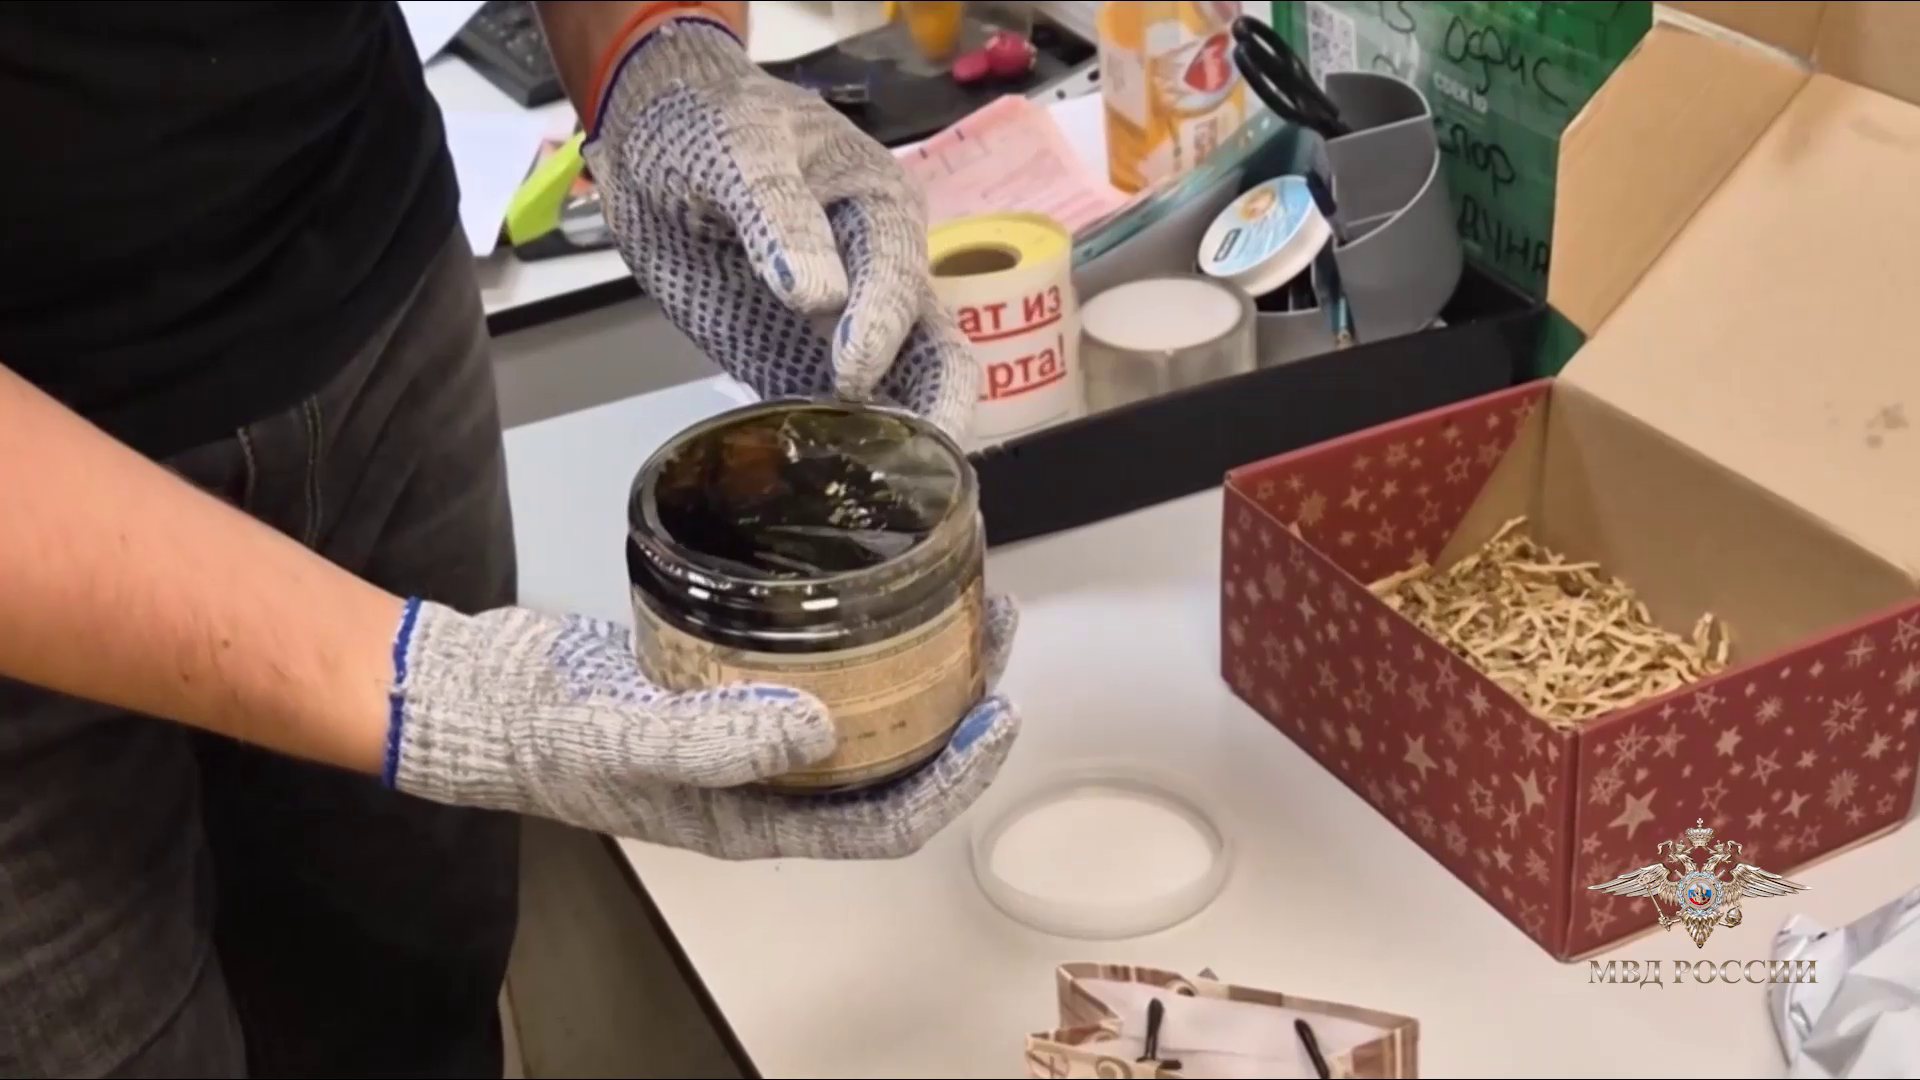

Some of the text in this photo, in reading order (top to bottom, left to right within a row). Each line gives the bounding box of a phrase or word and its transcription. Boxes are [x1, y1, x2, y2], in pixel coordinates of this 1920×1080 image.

[957, 284, 1062, 335] ат из
[982, 332, 1067, 401] рта!
